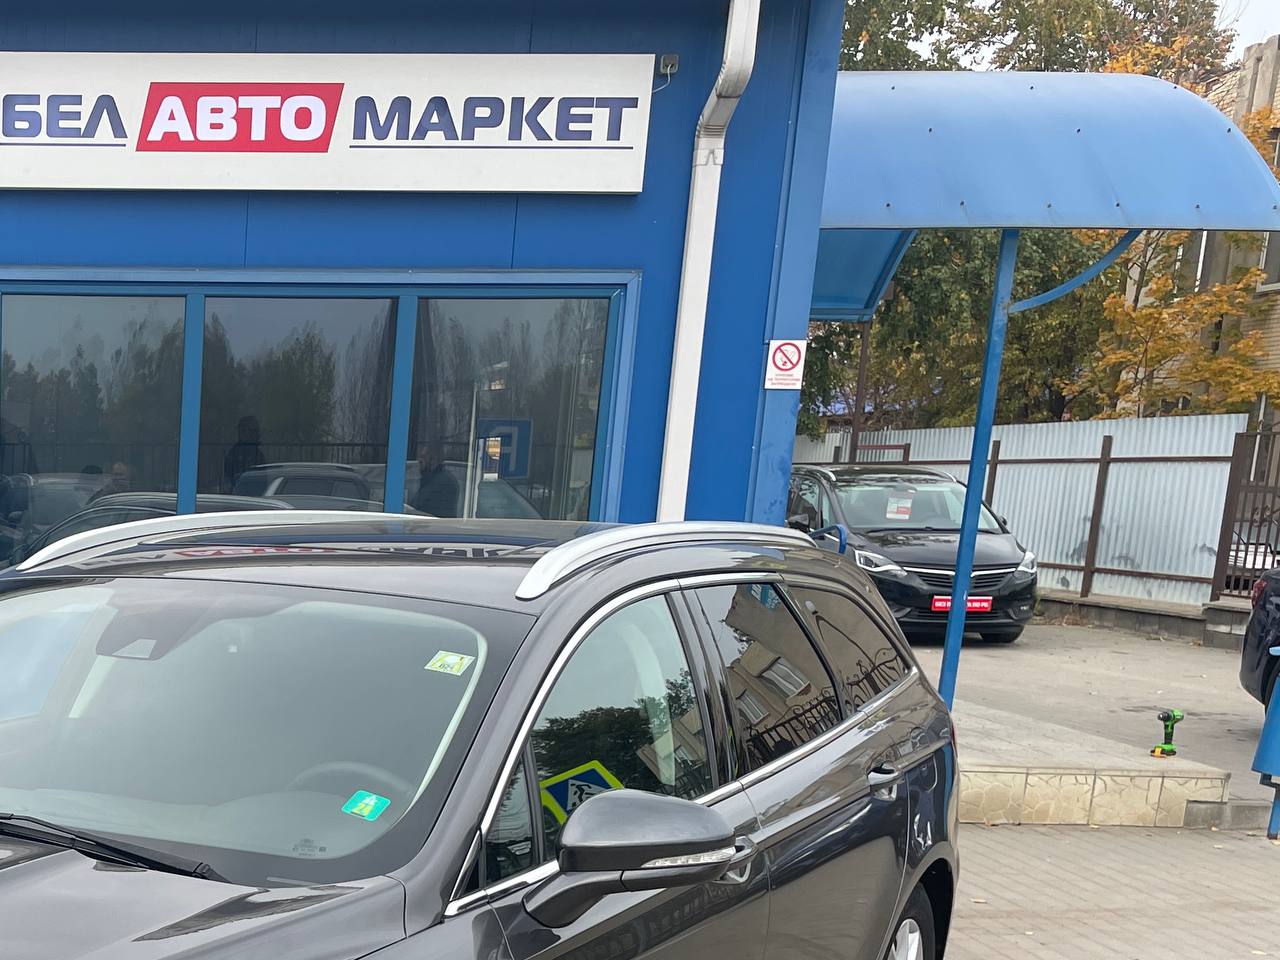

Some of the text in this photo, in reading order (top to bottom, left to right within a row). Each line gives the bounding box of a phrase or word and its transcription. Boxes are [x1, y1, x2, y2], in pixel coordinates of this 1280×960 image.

[1, 94, 639, 142] БЕЛ АВТО МАРКЕТ
